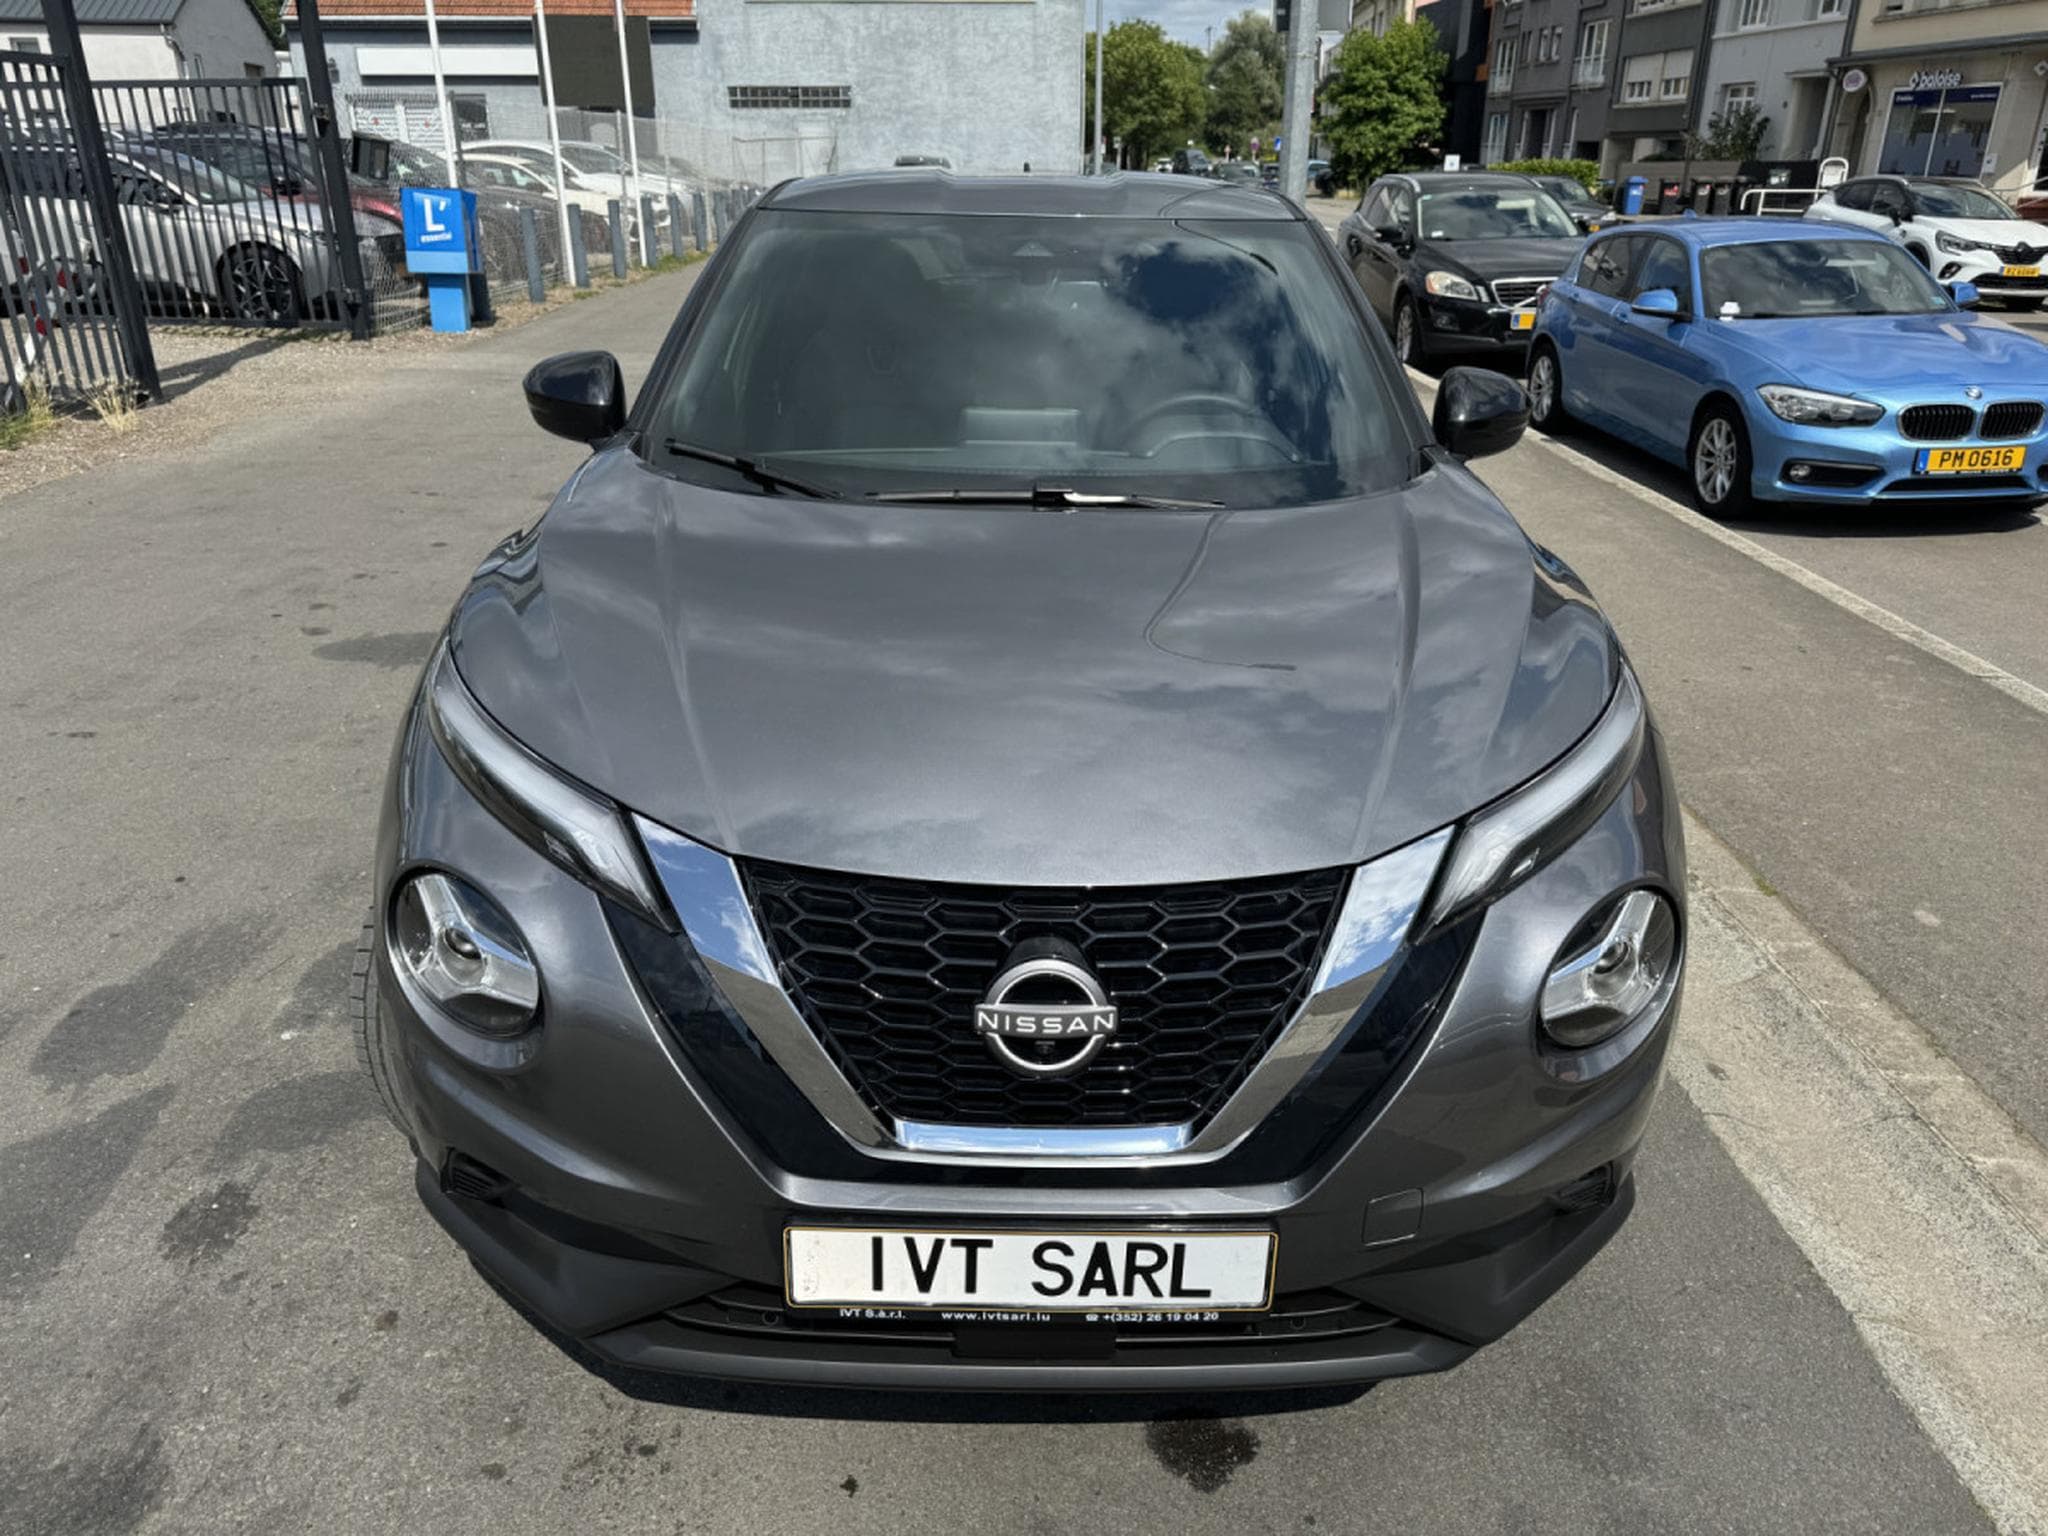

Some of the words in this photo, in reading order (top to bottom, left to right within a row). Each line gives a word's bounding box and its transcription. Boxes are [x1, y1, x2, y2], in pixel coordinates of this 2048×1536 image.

[1920, 68, 1961, 89] baloise
[1938, 450, 1966, 468] PM
[1968, 448, 2015, 467] 0616
[977, 1010, 1115, 1034] NISSAN
[871, 1236, 994, 1294] IVT
[1031, 1240, 1212, 1298] SARL
[840, 1308, 861, 1318] IVT
[941, 1311, 1050, 1321] www.ivtsarl.lu
[1103, 1312, 1142, 1323] +(352)
[1146, 1312, 1162, 1322] 26
[1167, 1312, 1181, 1321] 19
[1184, 1312, 1200, 1321] 04
[1203, 1311, 1219, 1321] 20
